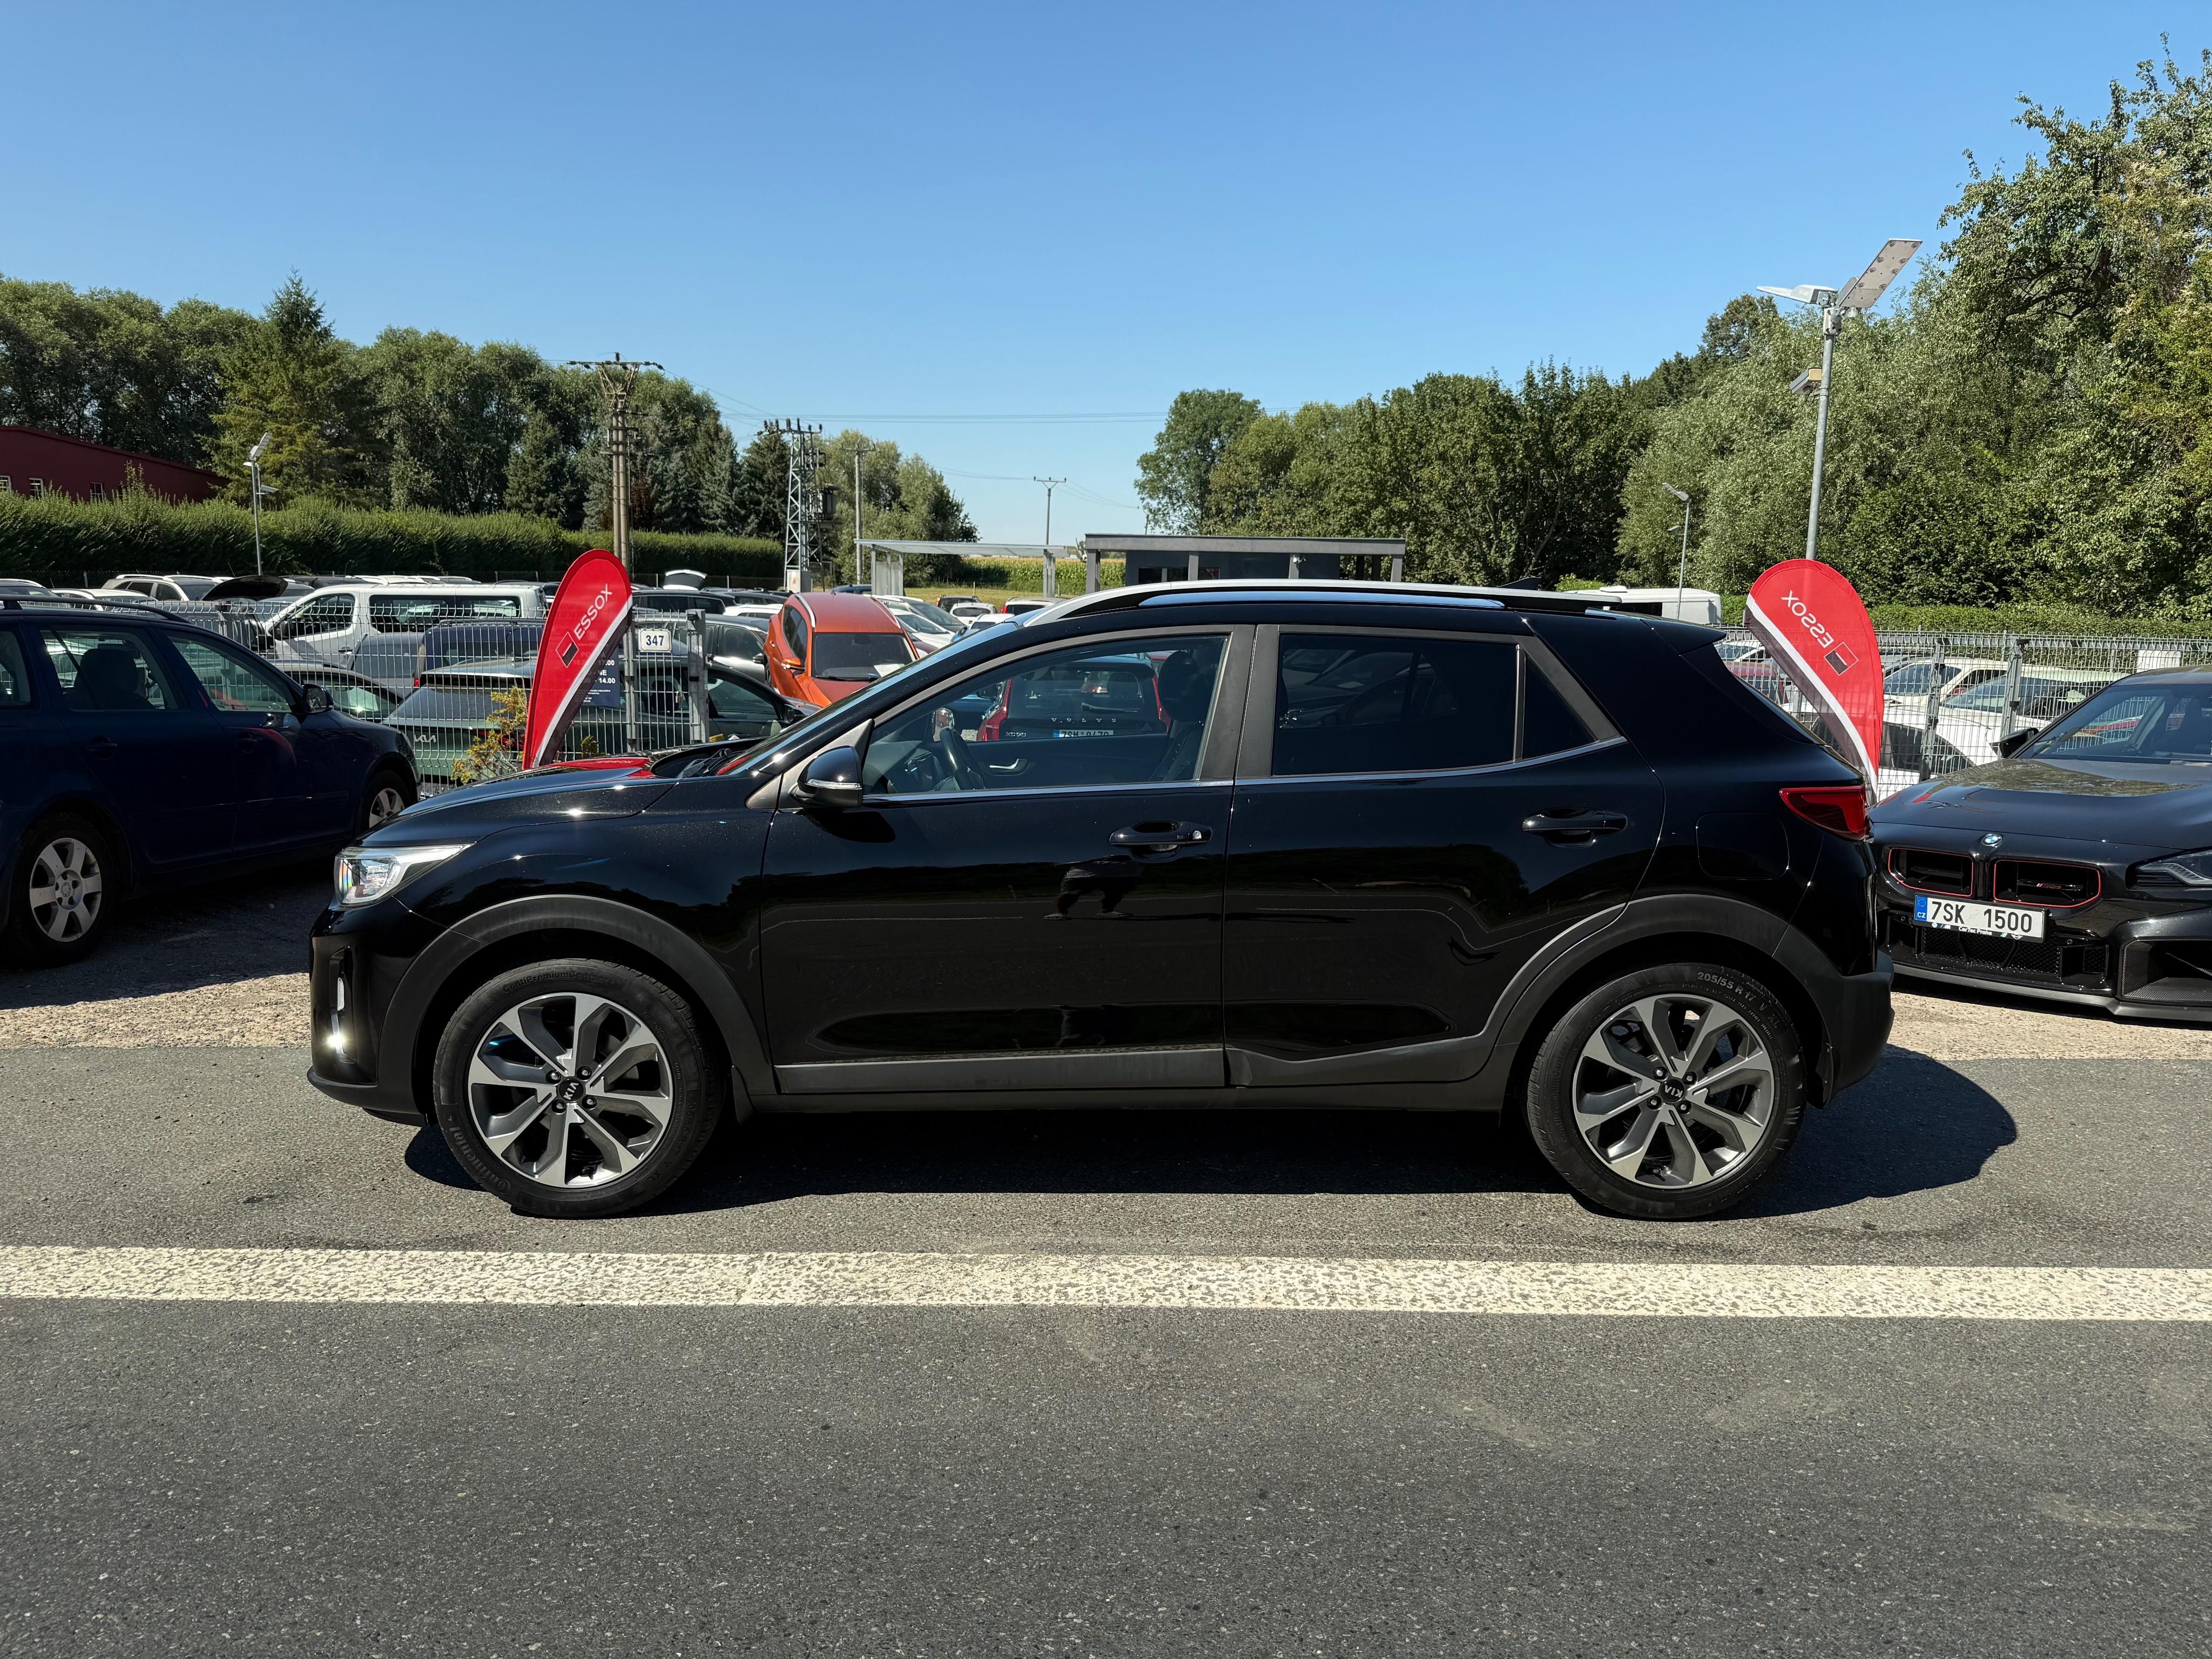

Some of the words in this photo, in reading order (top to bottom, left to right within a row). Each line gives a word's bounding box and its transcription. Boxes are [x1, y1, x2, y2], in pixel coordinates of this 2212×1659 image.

[574, 583, 612, 640] ESSOX
[646, 635, 664, 646] 347
[1931, 901, 1966, 925] 7SK
[1984, 908, 2032, 933] 1500
[1697, 972, 1734, 989] 205/55
[1735, 985, 1744, 995] R
[1745, 991, 1756, 1001] 17
[563, 1082, 579, 1100] KIA
[1664, 1084, 1683, 1098] KIA
